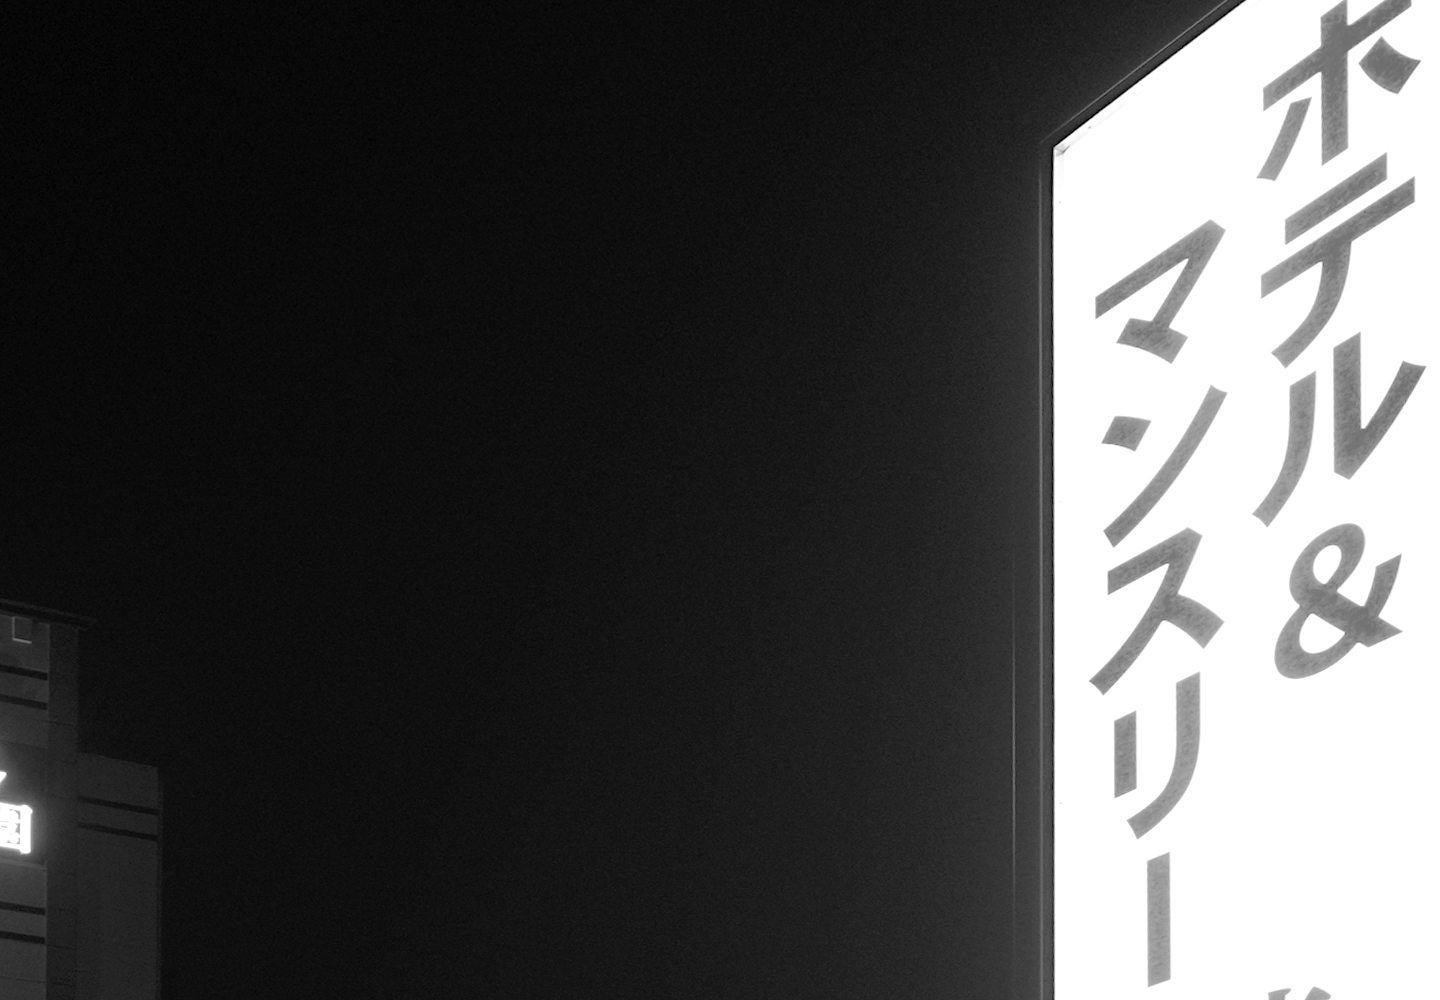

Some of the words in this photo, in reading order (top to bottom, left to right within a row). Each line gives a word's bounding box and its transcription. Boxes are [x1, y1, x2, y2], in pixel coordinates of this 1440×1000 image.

[1088, 219, 1228, 988] マンスリー
